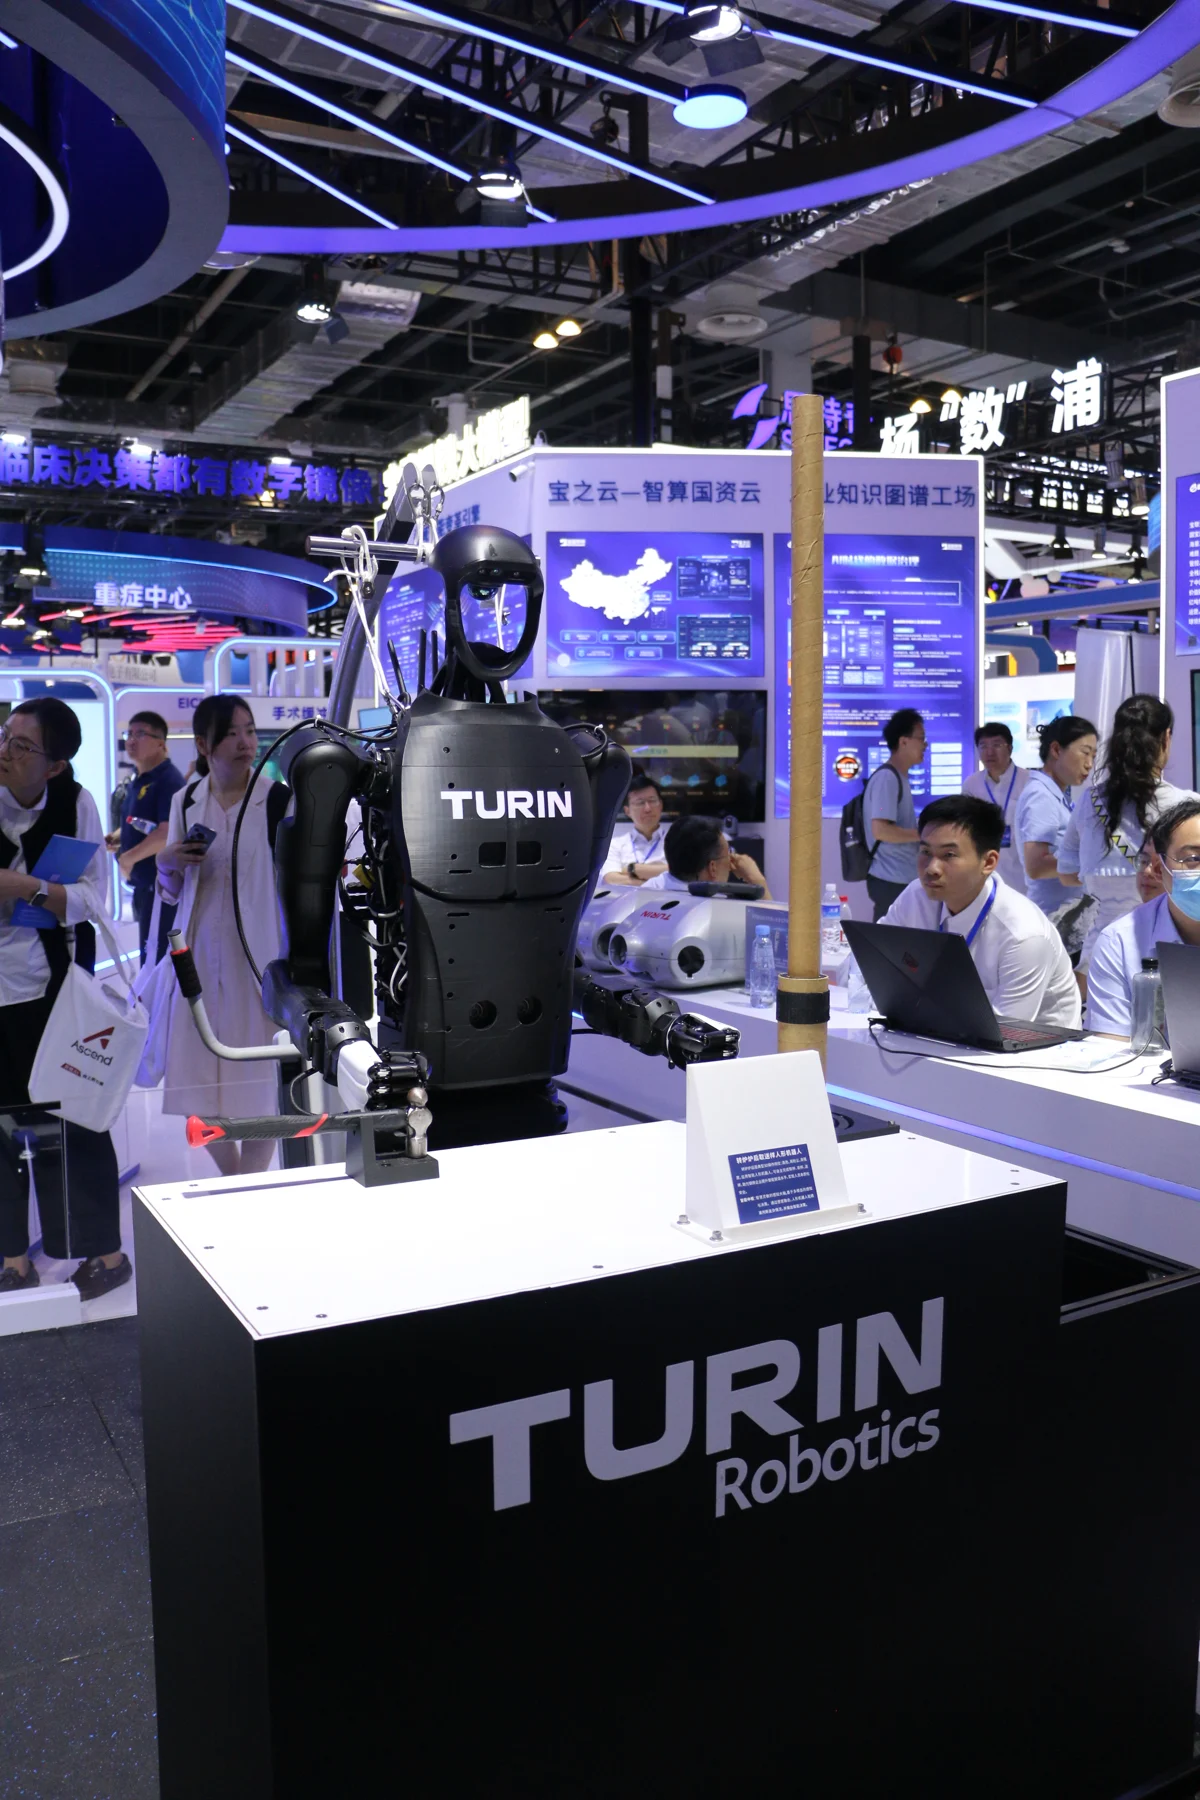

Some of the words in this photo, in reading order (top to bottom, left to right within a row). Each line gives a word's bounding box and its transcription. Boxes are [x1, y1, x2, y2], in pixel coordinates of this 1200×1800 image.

[1050, 357, 1102, 434] 浦
[93, 581, 193, 610] 重症中心
[440, 790, 573, 820] TURIN
[71, 1040, 113, 1066] Ascend
[449, 1296, 945, 1512] TURIN
[715, 1408, 941, 1519] Robotics
